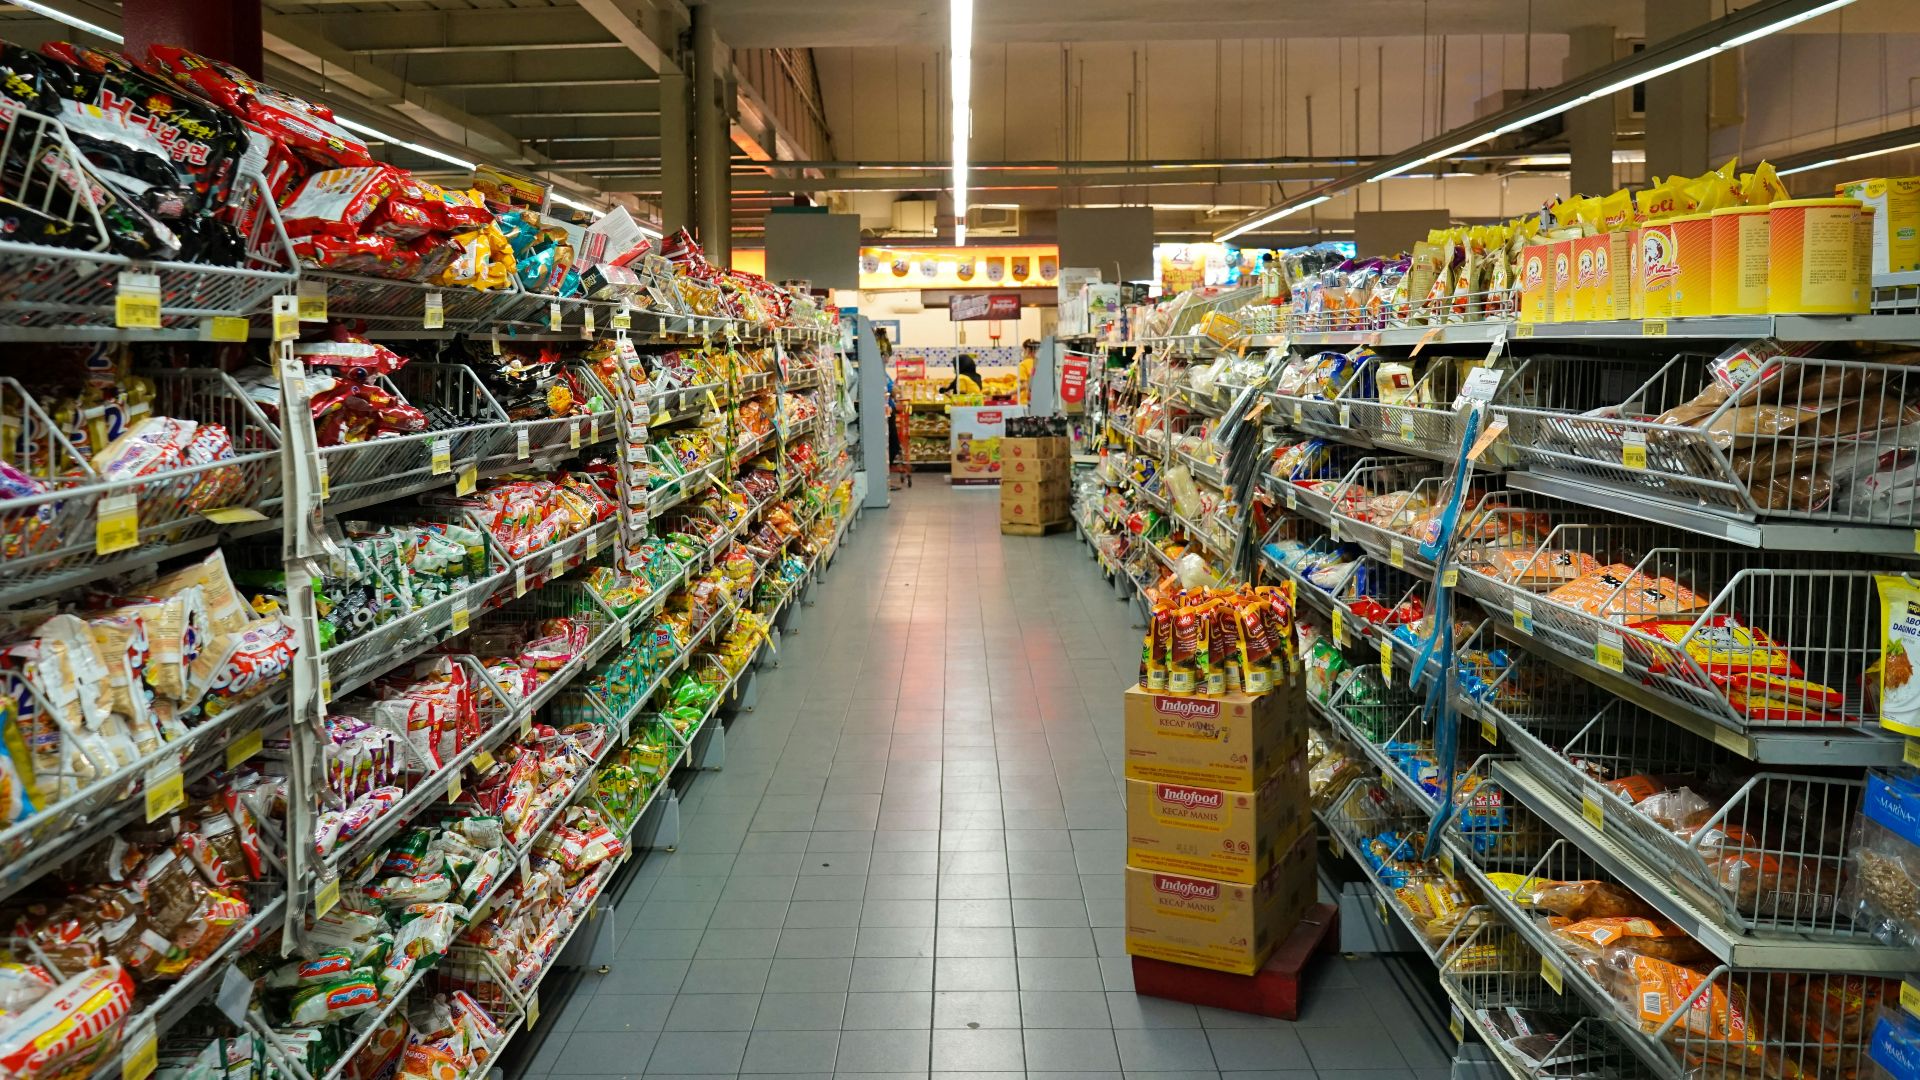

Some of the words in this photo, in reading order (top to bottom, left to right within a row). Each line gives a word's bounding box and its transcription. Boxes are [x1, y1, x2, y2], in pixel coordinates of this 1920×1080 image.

[104, 406, 128, 442] 2
[687, 449, 699, 462] 2
[728, 511, 739, 523] 2
[1906, 616, 1920, 627] ABO
[1161, 699, 1216, 716] Indofood
[1159, 719, 1186, 728] KECAP
[1164, 788, 1218, 806] Indofood
[1162, 807, 1189, 818] KECAP
[1190, 811, 1218, 822] MANIS
[1160, 878, 1215, 896] Indofood
[1159, 897, 1186, 908] KECAP
[1187, 901, 1216, 913] MANIS
